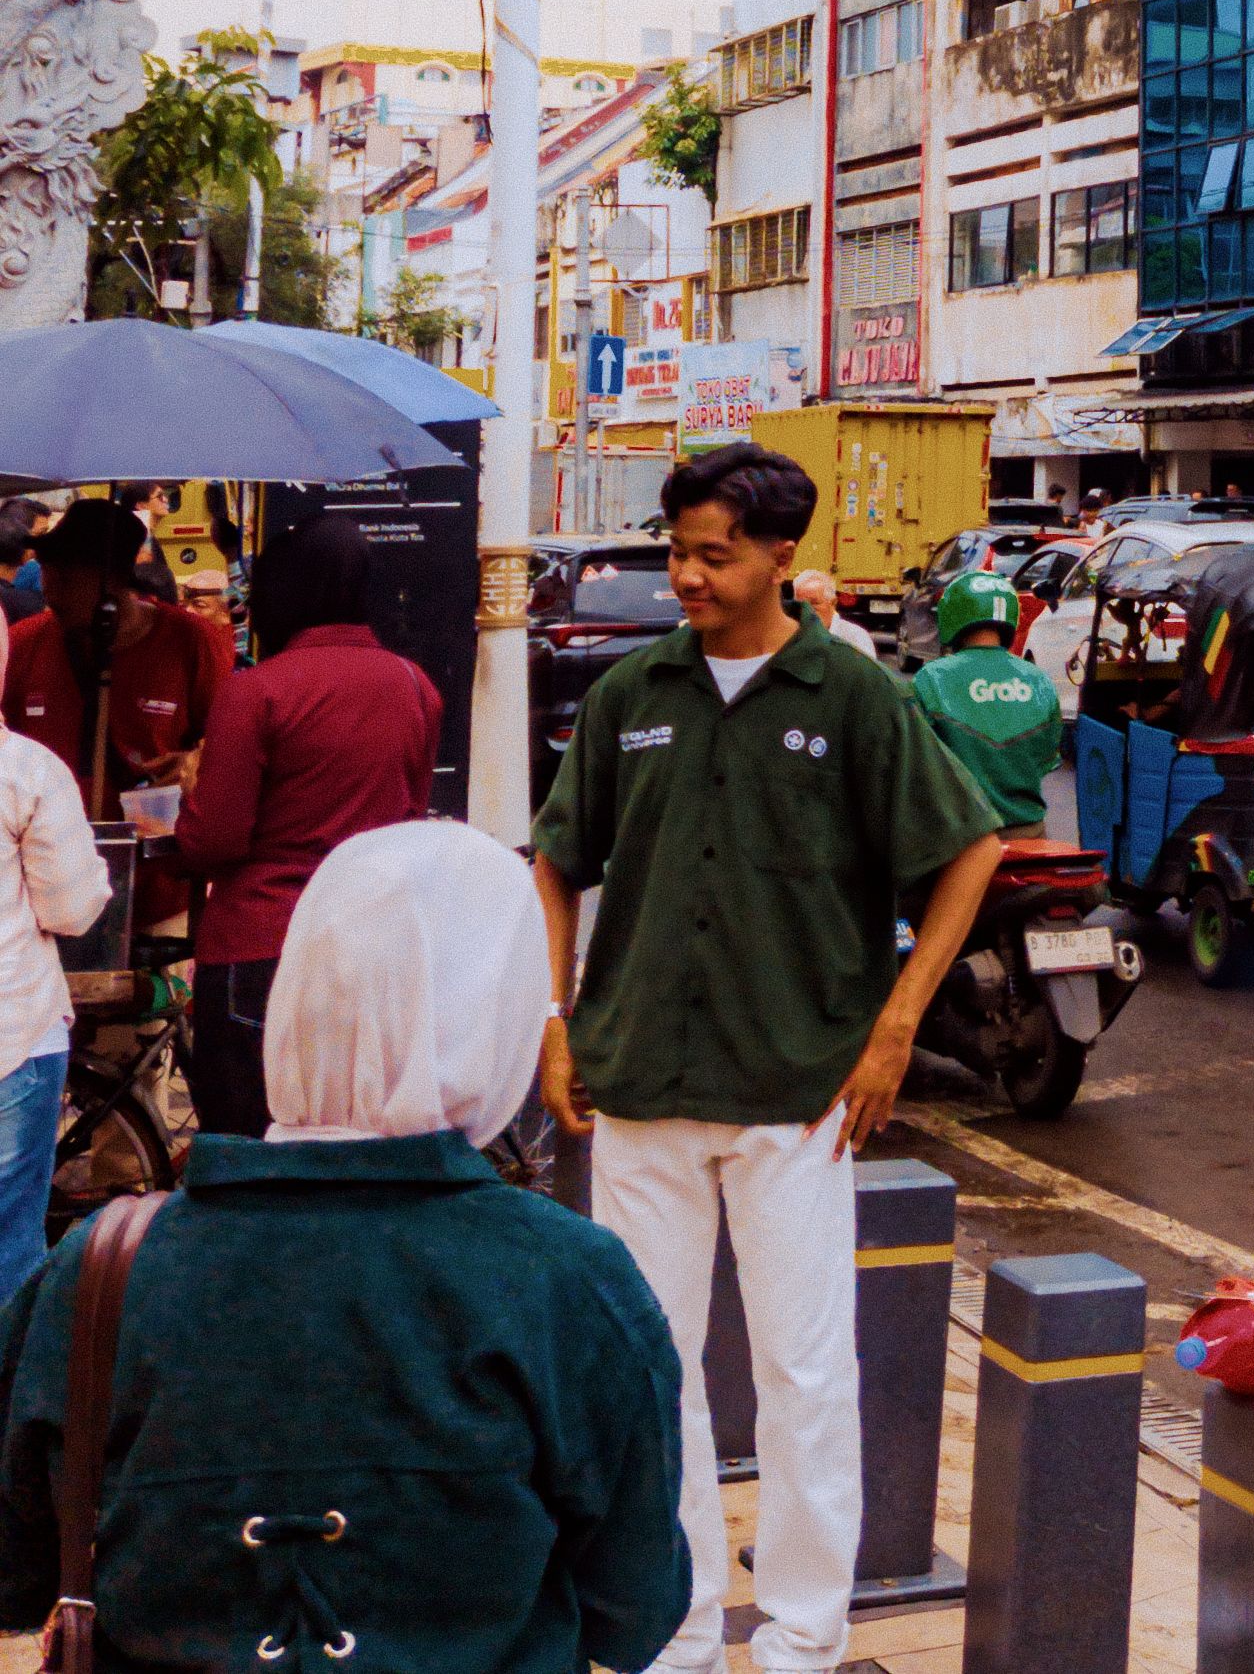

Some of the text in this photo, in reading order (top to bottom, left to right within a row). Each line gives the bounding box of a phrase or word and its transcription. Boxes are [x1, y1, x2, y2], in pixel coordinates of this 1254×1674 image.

[854, 316, 904, 341] TOKO
[695, 378, 721, 400] TOKO
[684, 404, 723, 432] SURYA
[968, 678, 1033, 703] Grab
